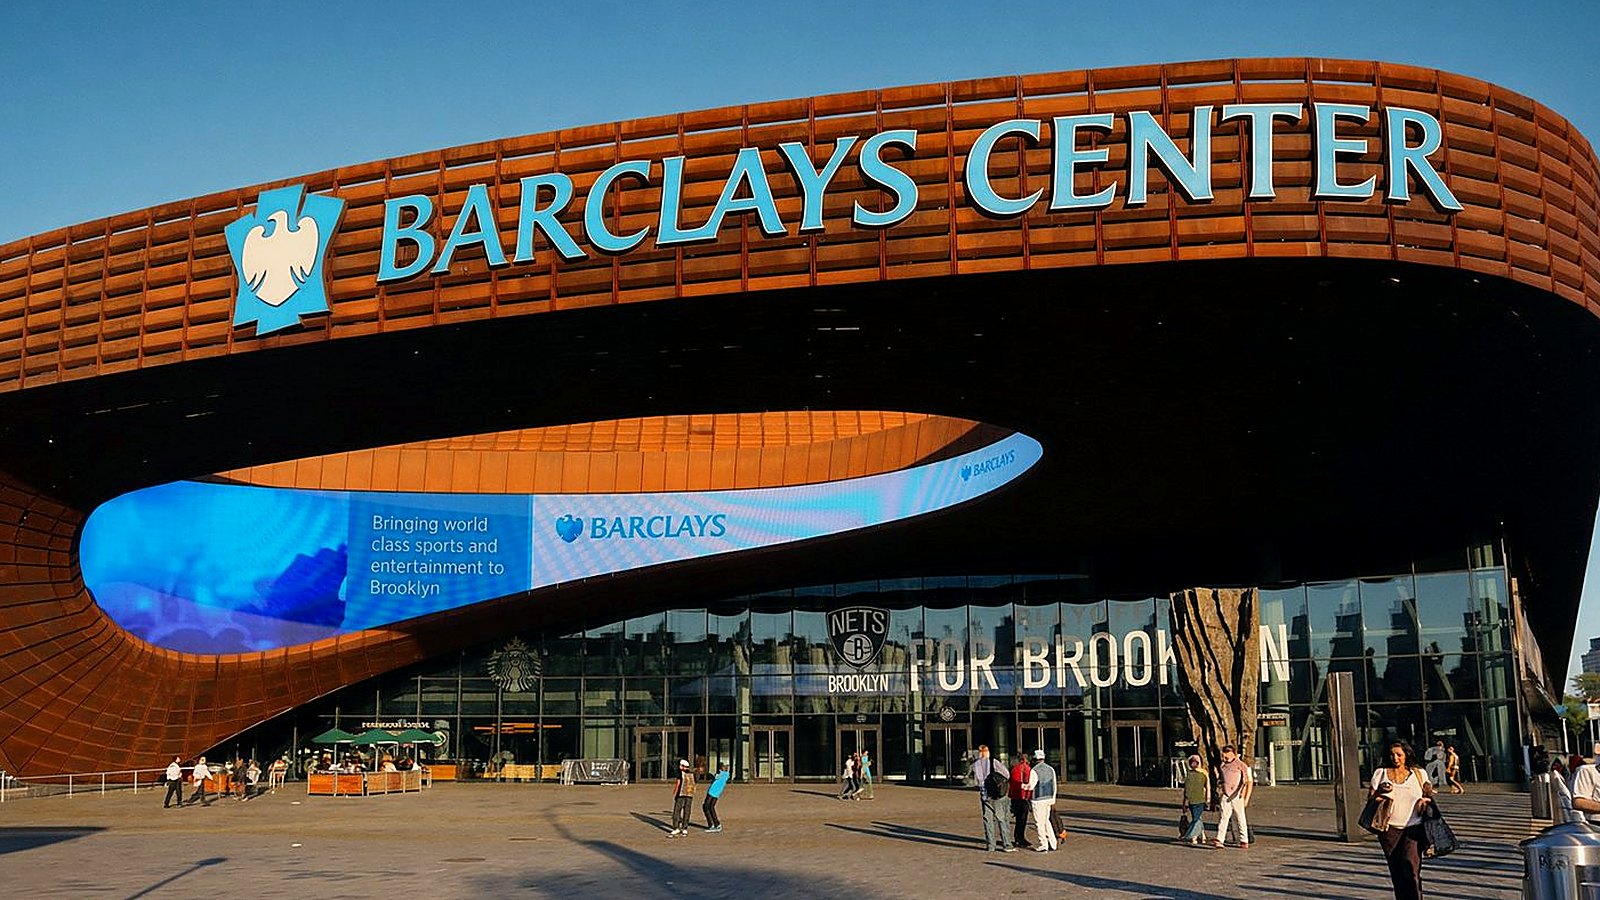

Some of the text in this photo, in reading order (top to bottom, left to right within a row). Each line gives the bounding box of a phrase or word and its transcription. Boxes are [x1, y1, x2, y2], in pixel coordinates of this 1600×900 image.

[377, 101, 1465, 283] BARCLAYS CENTER
[973, 449, 1015, 477] BARCLAYS
[373, 515, 488, 534] Bringing world
[590, 513, 726, 539] BARCLAYS
[371, 536, 498, 555] class sports and
[370, 559, 505, 575] entertainment to
[370, 580, 440, 598] Brooklyn
[832, 609, 885, 637] NETS
[1023, 624, 1291, 690] BROOKN
[828, 674, 889, 693] BROOKLYN
